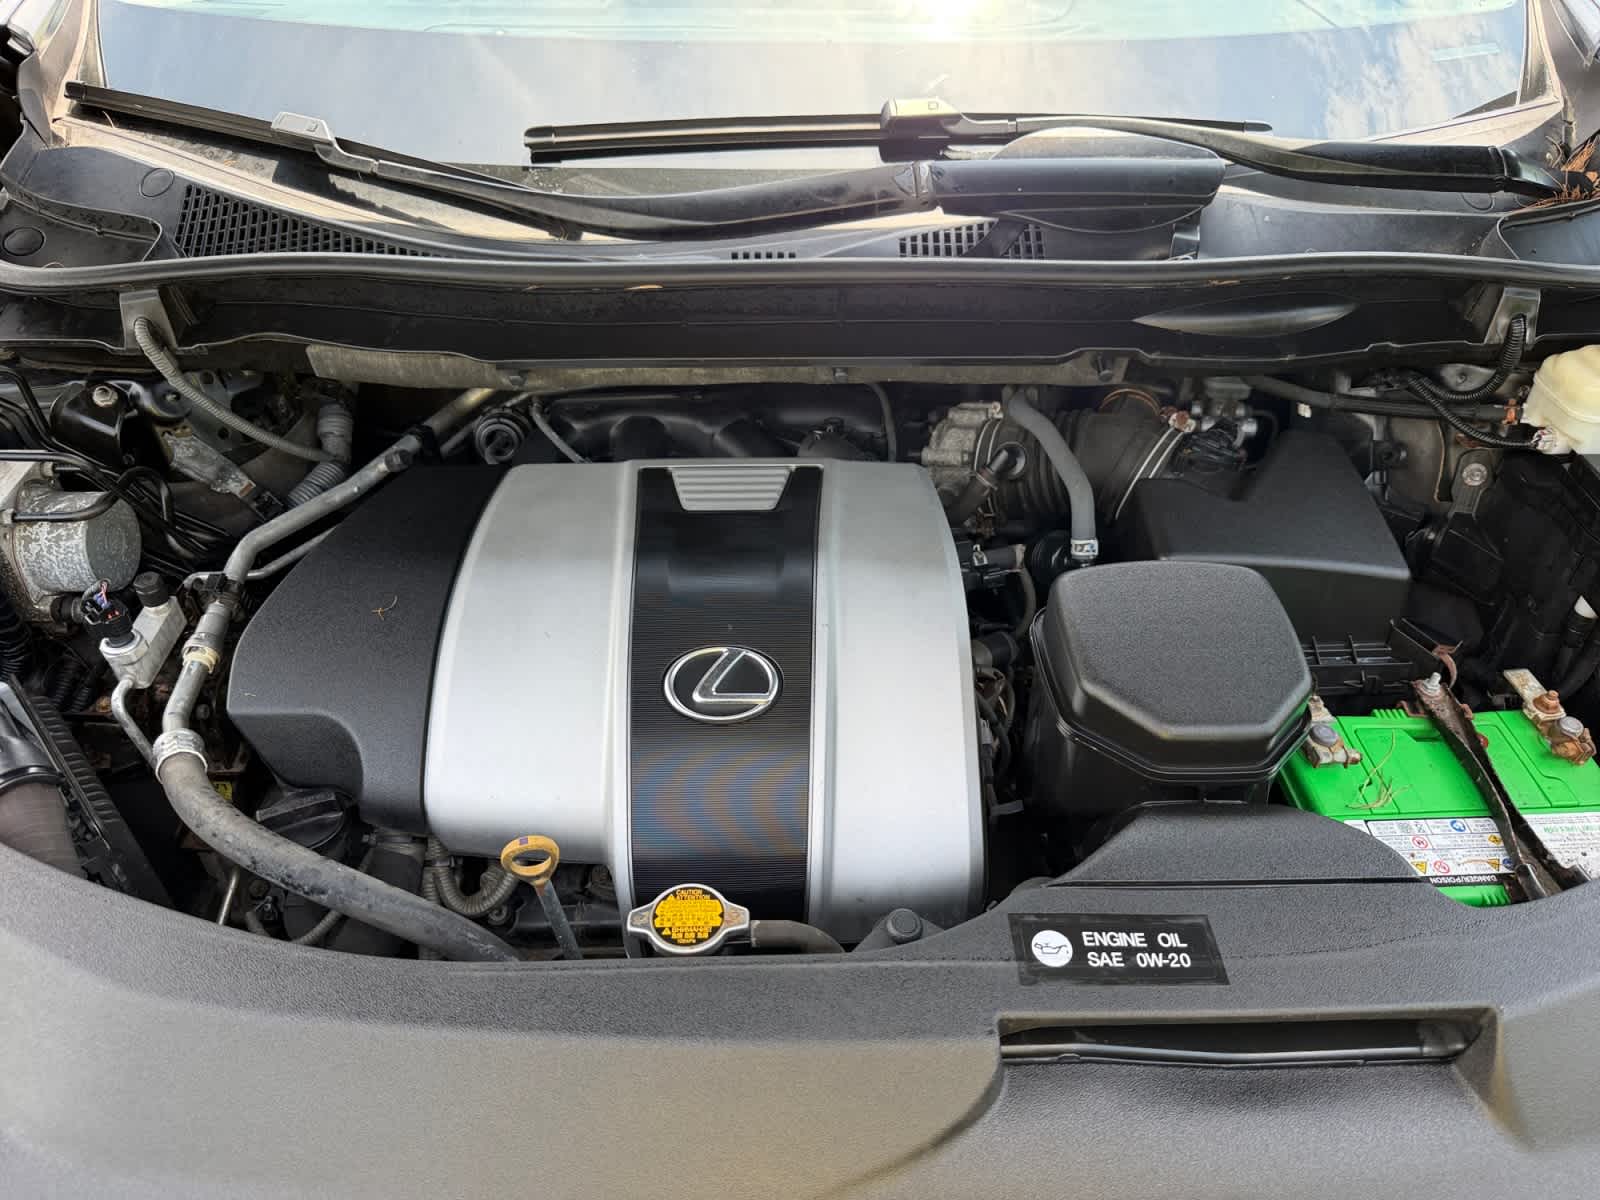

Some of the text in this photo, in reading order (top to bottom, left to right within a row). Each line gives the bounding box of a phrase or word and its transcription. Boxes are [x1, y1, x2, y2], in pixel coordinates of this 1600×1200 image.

[1082, 931, 1188, 948] ENGINE OIL
[1087, 952, 1191, 968] SAE 0W-20
